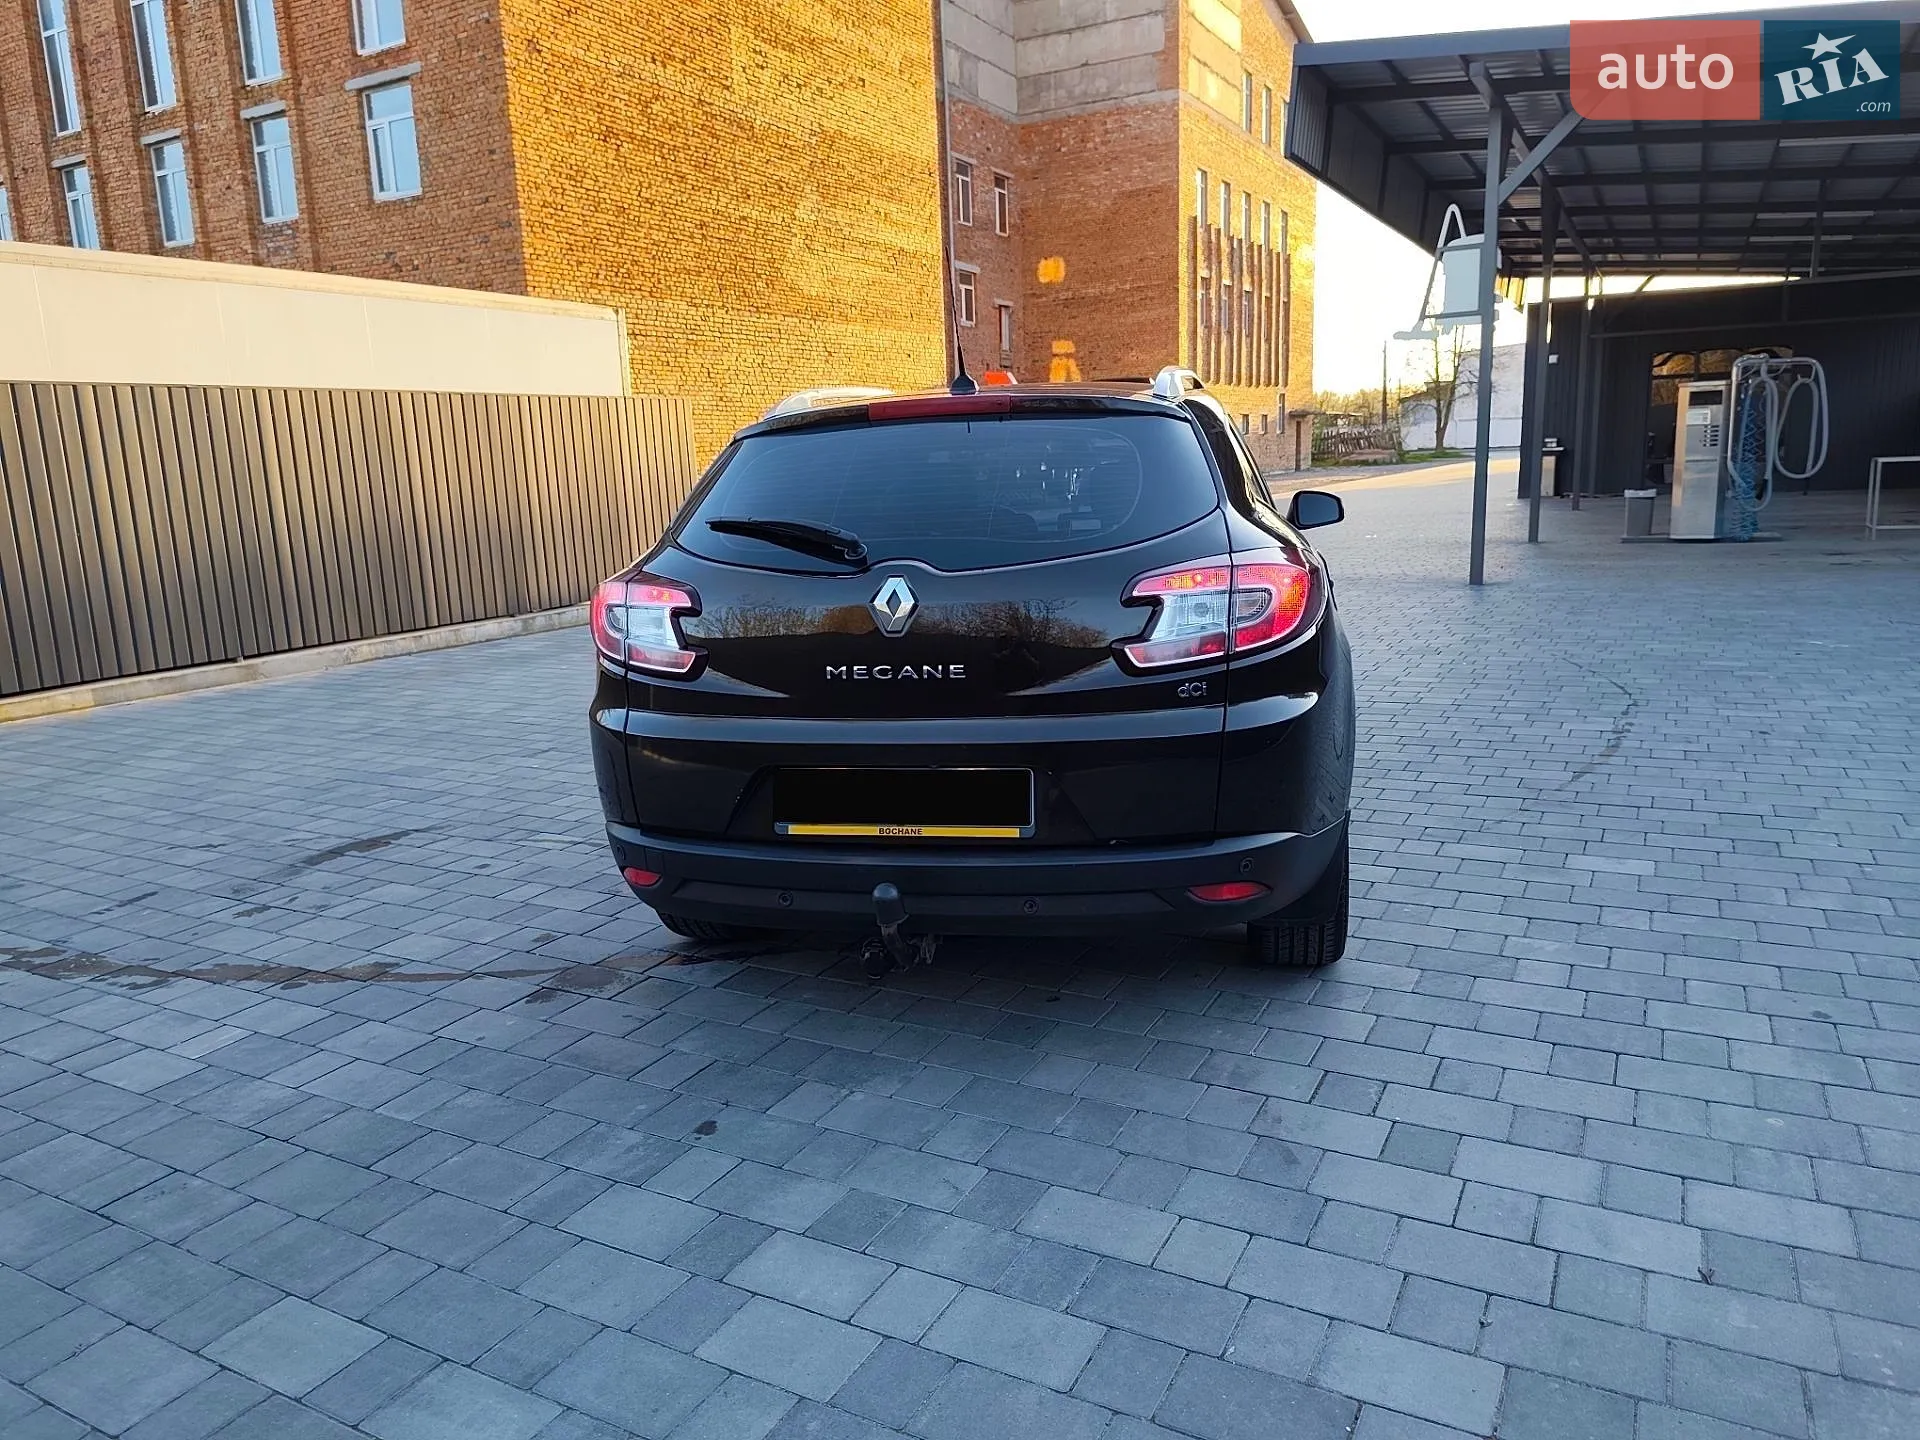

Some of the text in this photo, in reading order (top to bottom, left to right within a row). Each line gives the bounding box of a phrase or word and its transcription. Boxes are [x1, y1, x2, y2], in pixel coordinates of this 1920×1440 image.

[825, 664, 966, 680] MEGANE
[1177, 681, 1207, 698] dCi
[878, 827, 924, 835] BOCHANE
